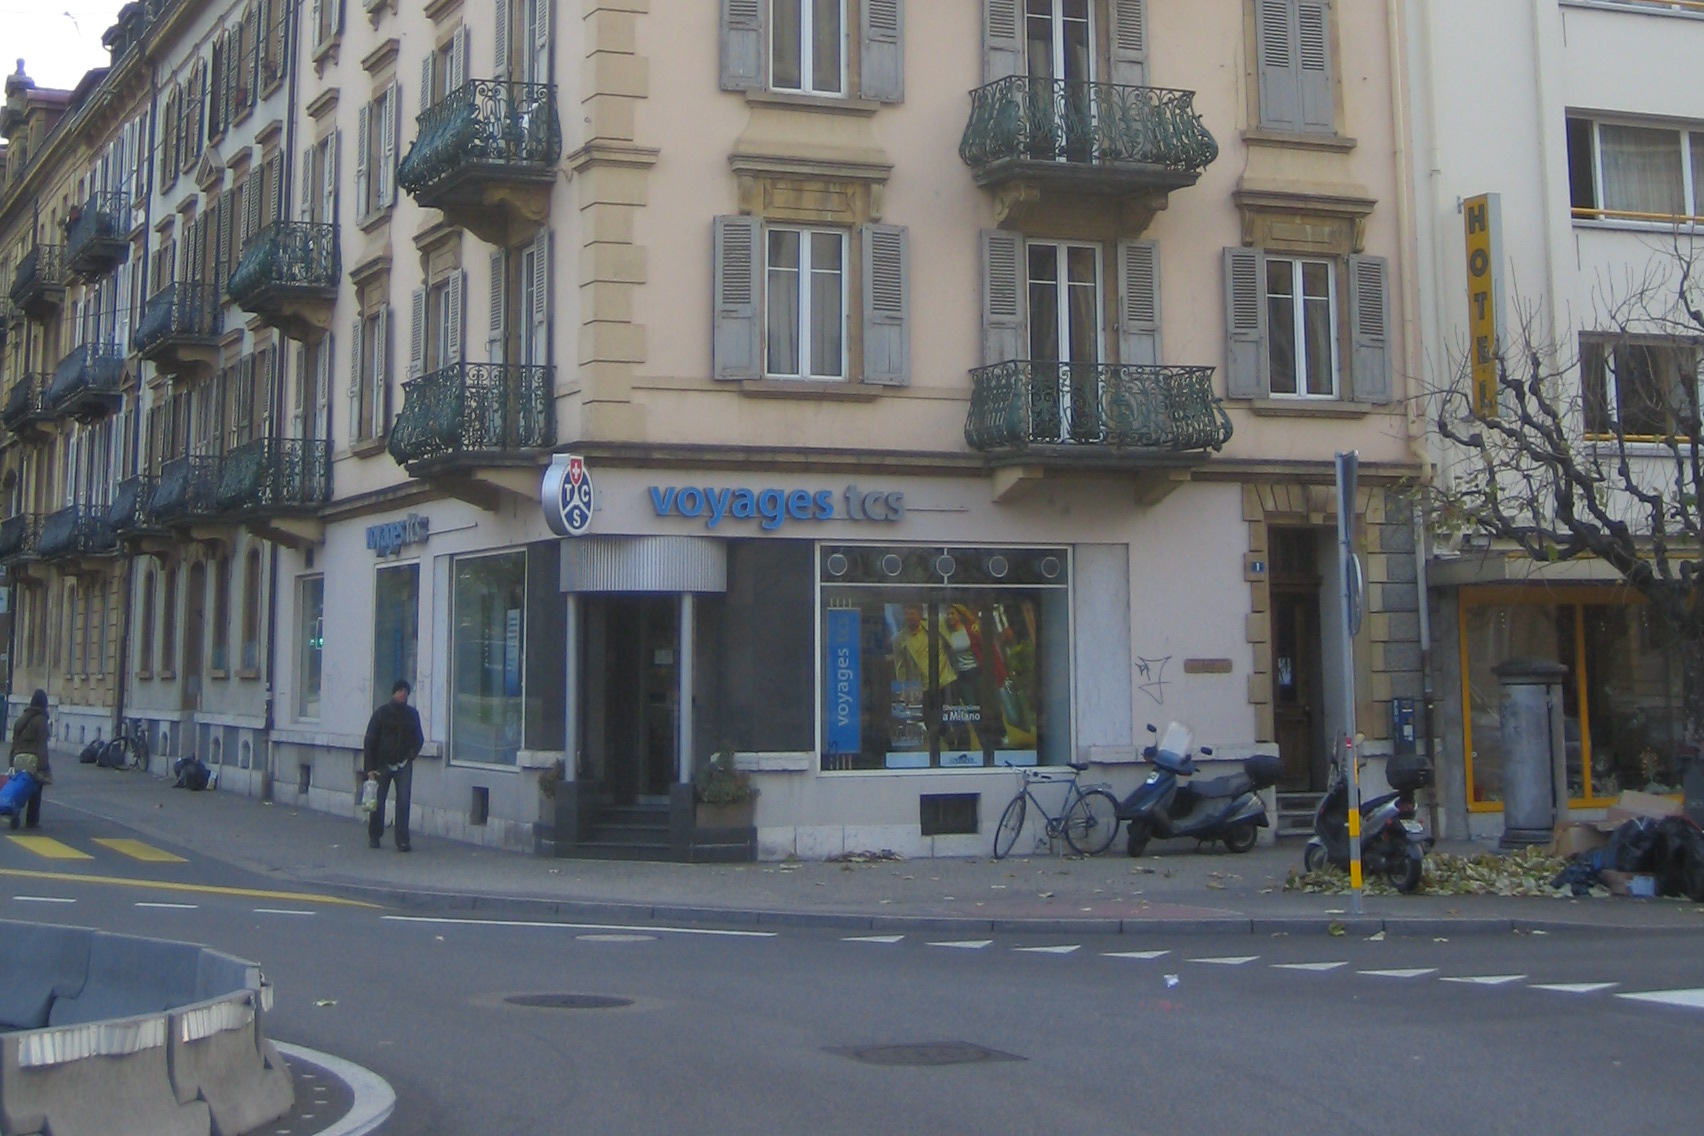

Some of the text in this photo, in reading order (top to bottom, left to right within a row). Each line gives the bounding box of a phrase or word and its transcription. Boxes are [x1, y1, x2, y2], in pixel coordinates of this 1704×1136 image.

[1468, 203, 1494, 411] HOTEL
[564, 483, 590, 528] TCS
[650, 484, 904, 531] voyages tcs
[837, 647, 853, 727] voyages
[950, 711, 981, 721] Milano
